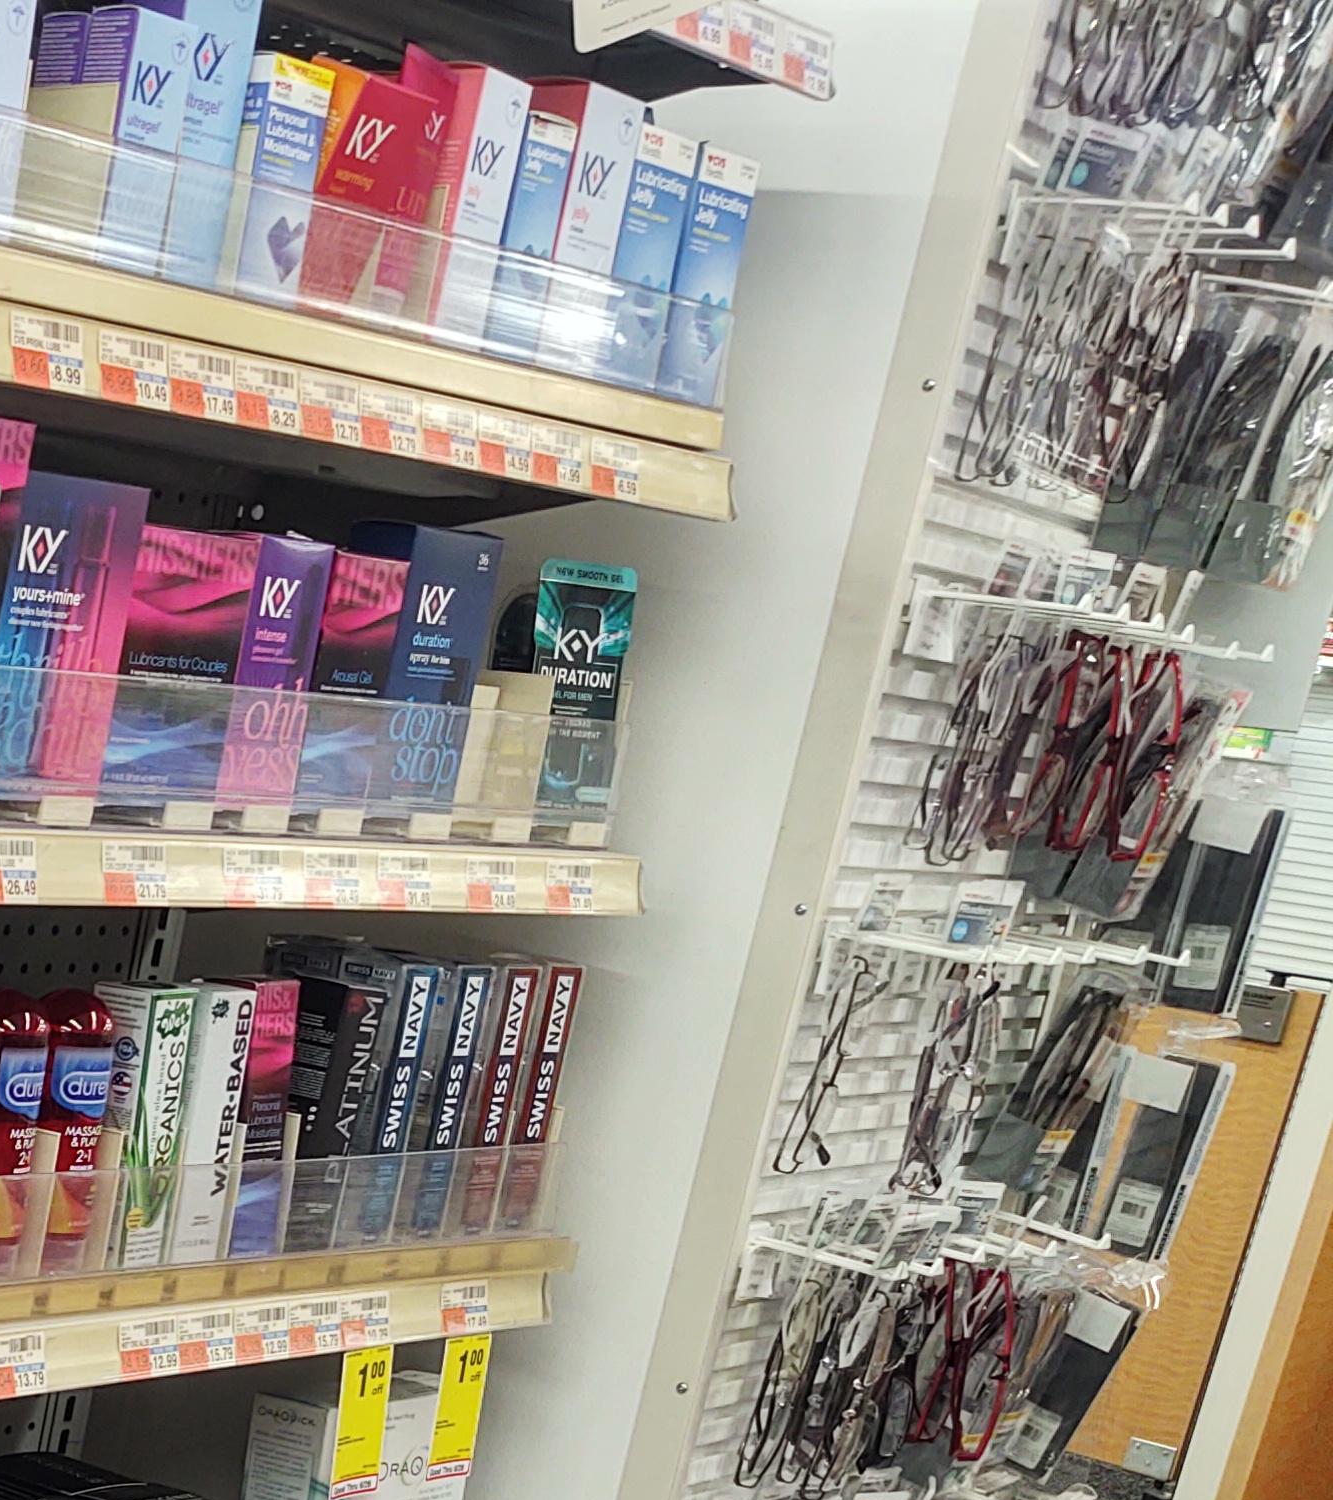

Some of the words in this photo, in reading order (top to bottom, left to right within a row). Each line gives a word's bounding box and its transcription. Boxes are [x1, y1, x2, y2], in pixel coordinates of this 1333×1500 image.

[699, 189, 748, 219] Lubricating
[695, 209, 718, 229] Jelly
[555, 566, 574, 578] NEW
[577, 569, 608, 582] SMOOTH
[413, 634, 450, 649] duration
[383, 1065, 409, 1149] SWISS
[404, 977, 428, 1051] NAVY
